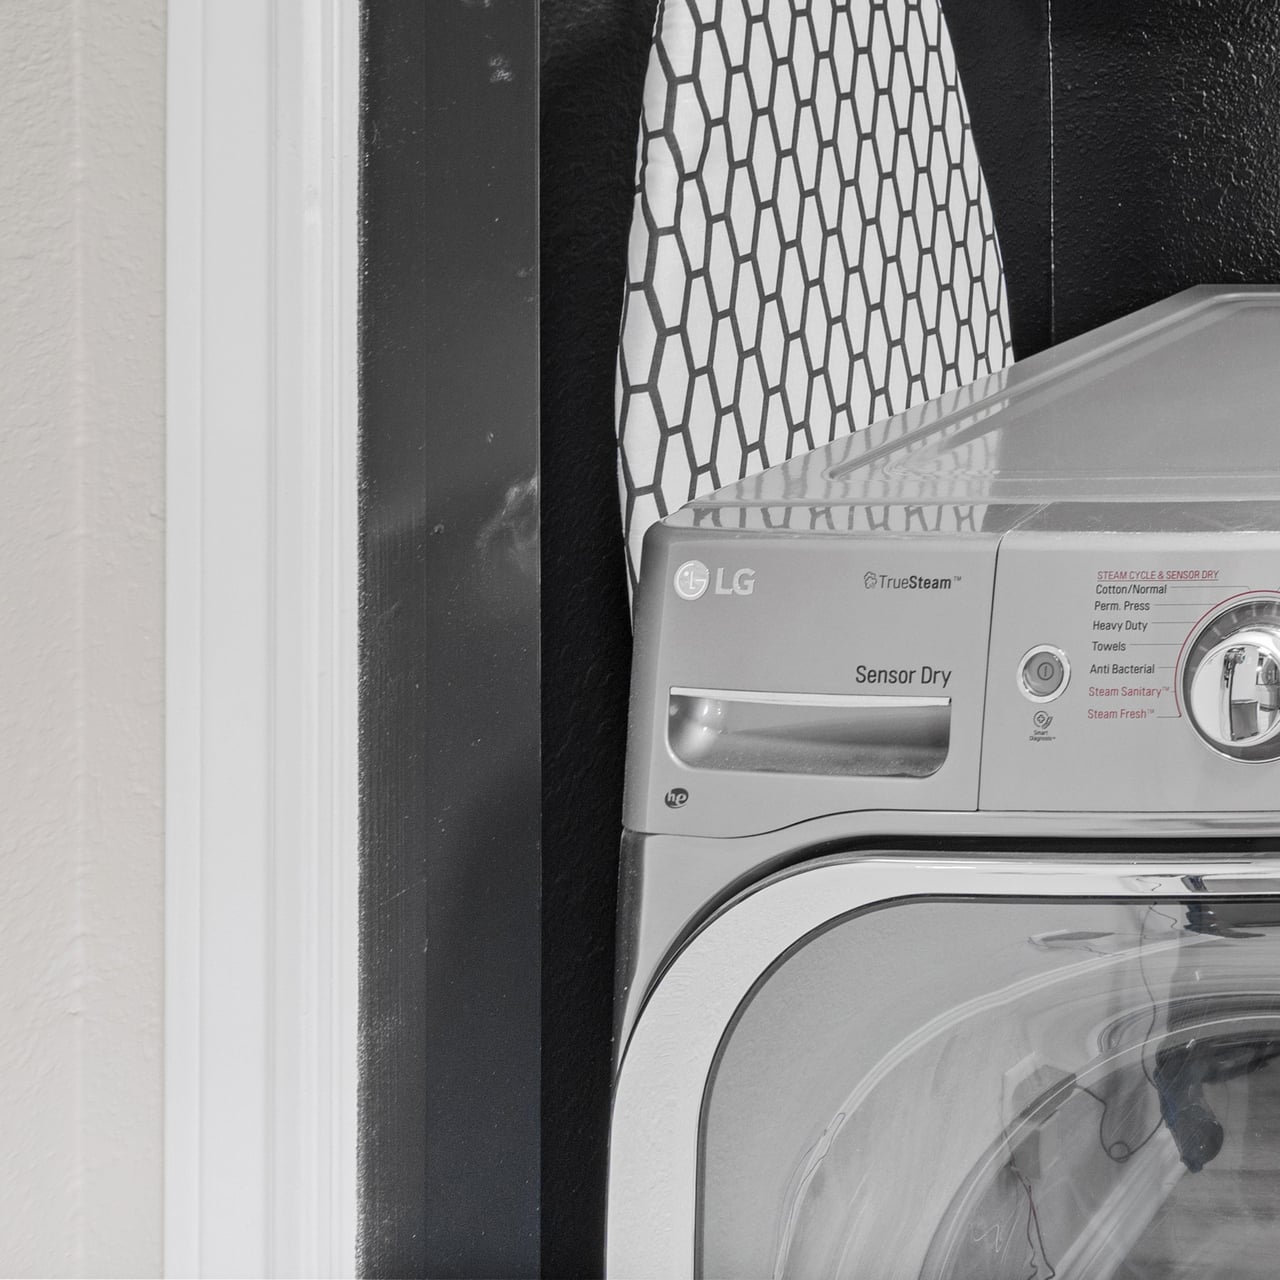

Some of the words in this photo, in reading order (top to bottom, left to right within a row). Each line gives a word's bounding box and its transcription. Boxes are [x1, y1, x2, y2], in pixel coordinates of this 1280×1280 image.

[1097, 571, 1128, 580] STEAM
[1129, 571, 1157, 580] CYCLE
[1166, 570, 1200, 580] SENSOR
[1201, 570, 1219, 579] DRY
[715, 568, 756, 595] LG
[1096, 584, 1167, 595] Cotton/Normal
[1124, 601, 1150, 610] Press
[1093, 621, 1123, 632] Heavy
[1125, 620, 1148, 632] Duty
[1092, 641, 1126, 652] Towels
[1090, 665, 1110, 674] Anti
[1112, 664, 1155, 674] Bacterial
[855, 665, 916, 685] Sensor
[921, 666, 952, 688] Dry
[1088, 687, 1119, 697] Steam
[1087, 709, 1117, 719] Steam
